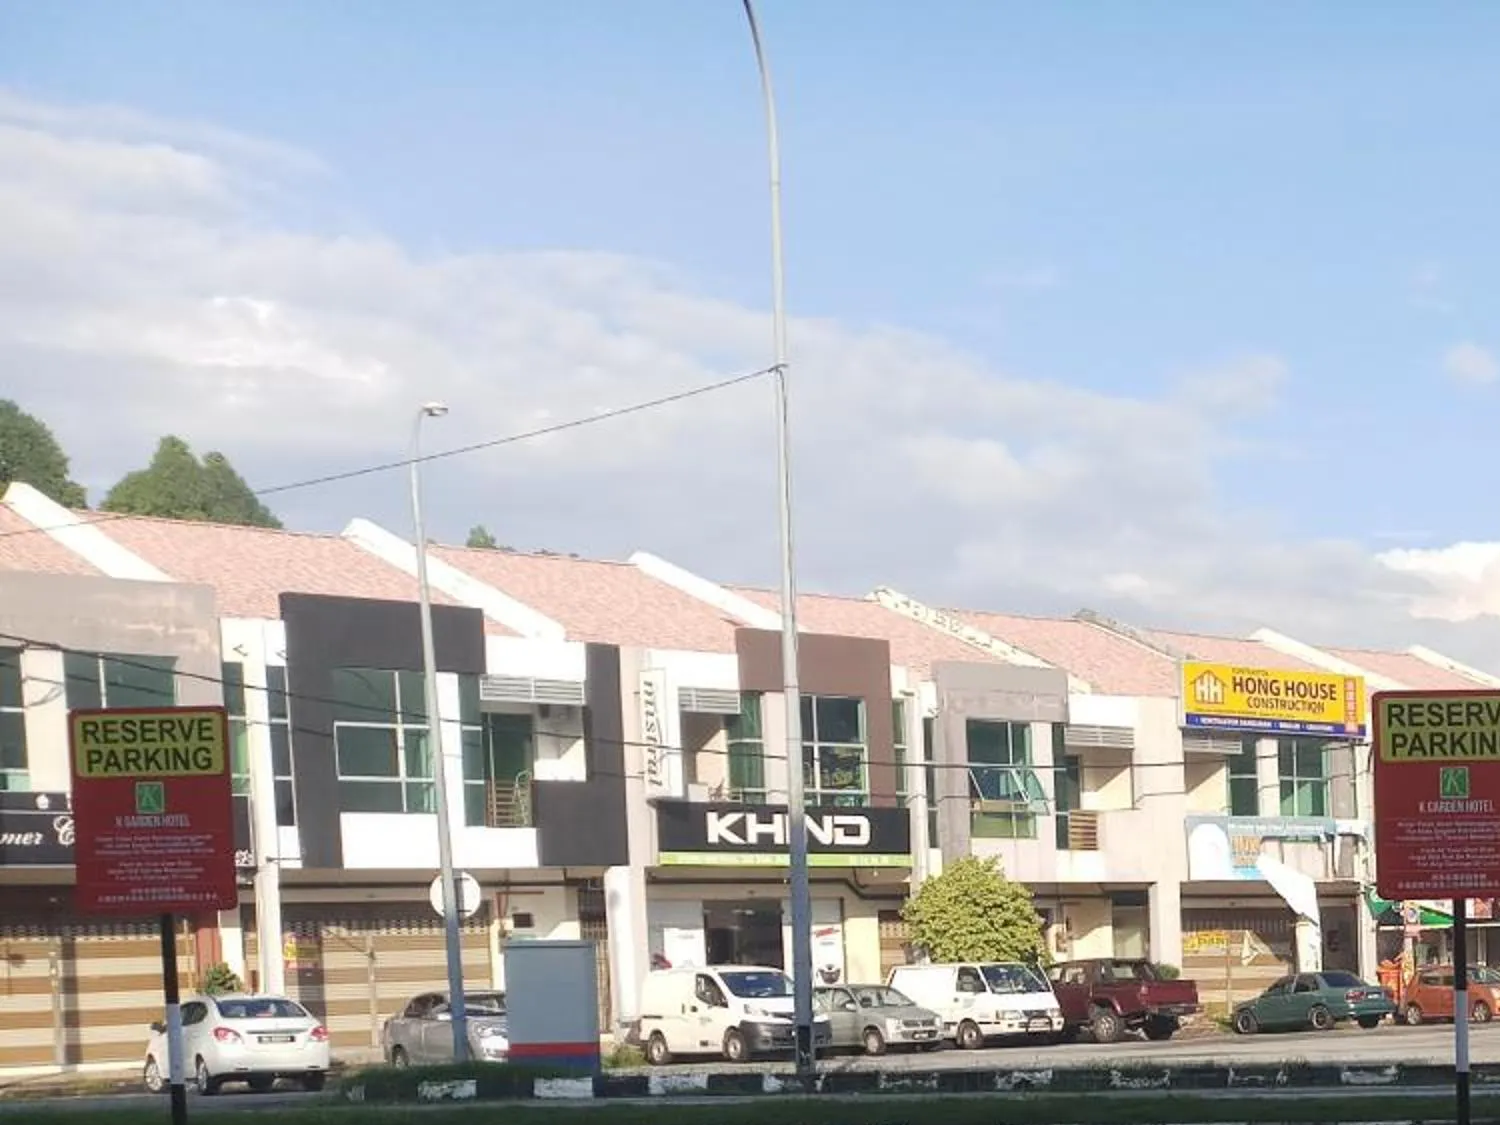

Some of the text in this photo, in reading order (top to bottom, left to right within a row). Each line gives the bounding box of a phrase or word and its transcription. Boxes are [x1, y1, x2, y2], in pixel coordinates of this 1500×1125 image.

[1232, 676, 1337, 701] HONG HOUSE
[1247, 696, 1325, 713] CONSTRUCTION
[81, 718, 215, 744] RESERVE
[87, 748, 213, 773] PARKING
[1427, 799, 1465, 812] GARDEN
[1465, 799, 1494, 812] HOTEL
